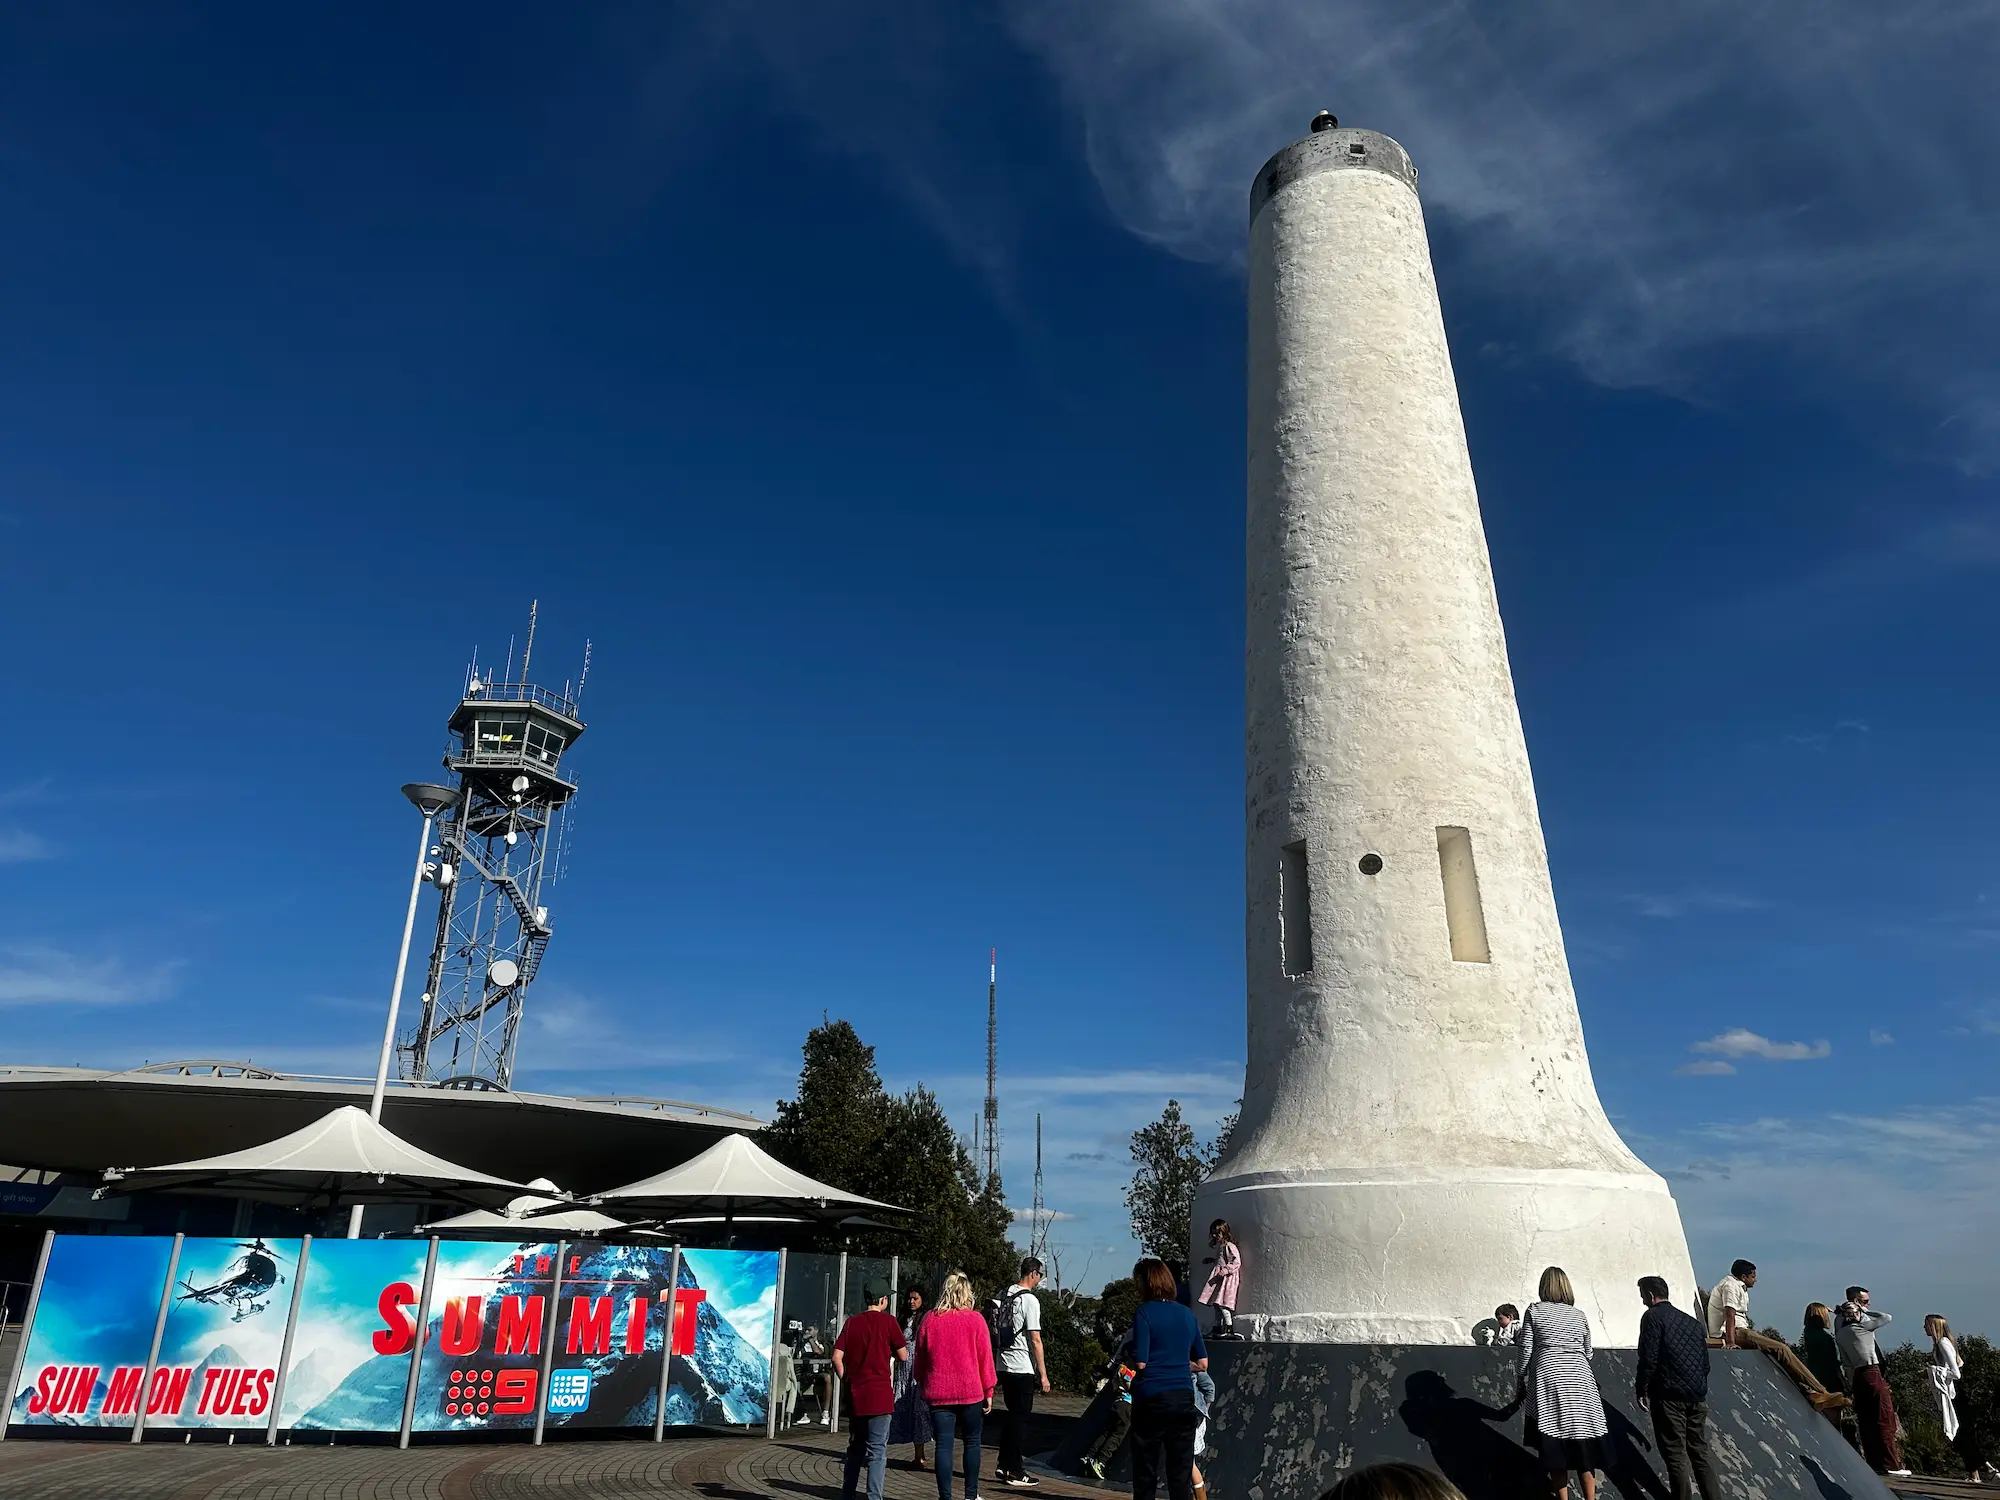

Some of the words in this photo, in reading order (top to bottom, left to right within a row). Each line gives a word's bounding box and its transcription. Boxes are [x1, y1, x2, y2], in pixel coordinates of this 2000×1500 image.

[3, 1193, 16, 1203] gift
[18, 1195, 36, 1204] shop
[513, 1254, 581, 1274] THE
[372, 1281, 707, 1356] SUMMIT
[29, 1366, 100, 1414] SUN
[102, 1367, 192, 1415] MON
[197, 1368, 275, 1416] TUES
[493, 1368, 539, 1414] 9
[551, 1394, 586, 1407] NOW
